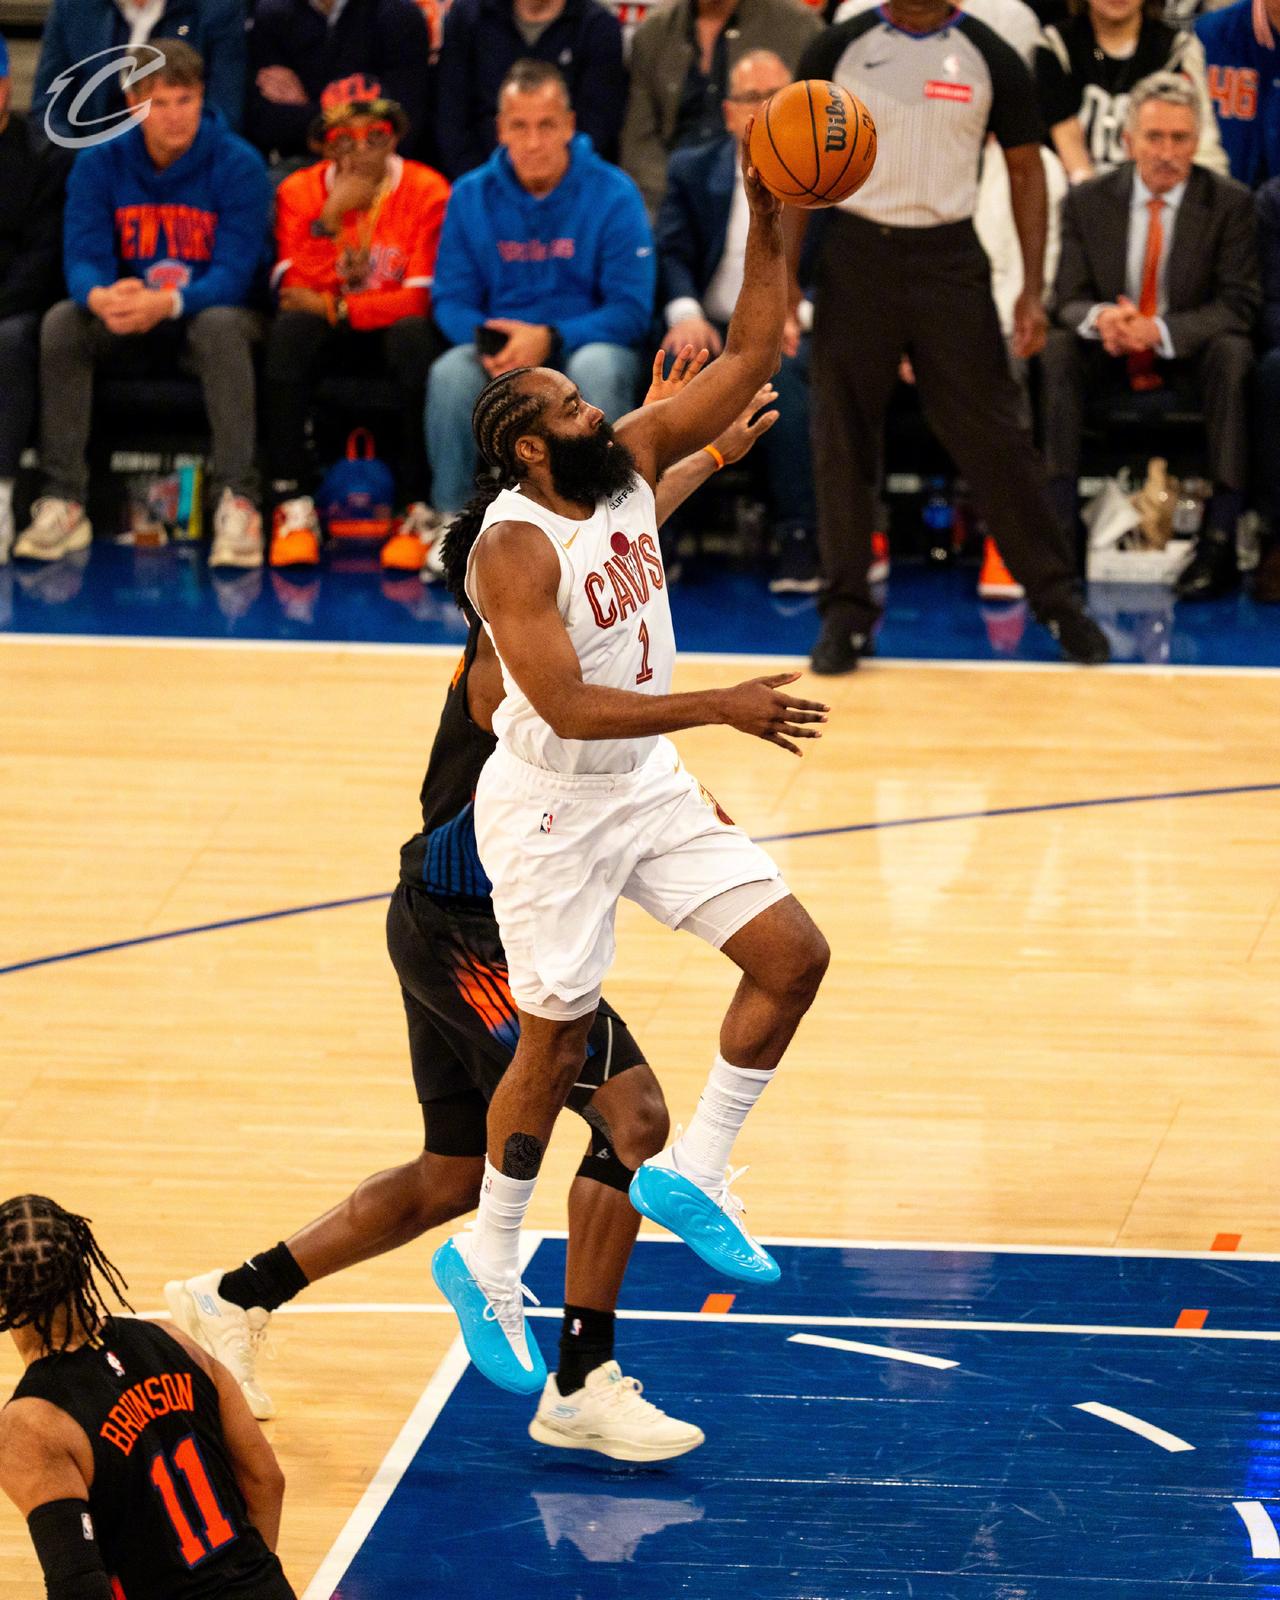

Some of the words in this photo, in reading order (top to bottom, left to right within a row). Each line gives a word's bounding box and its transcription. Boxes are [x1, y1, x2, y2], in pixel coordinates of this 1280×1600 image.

[1208, 64, 1260, 120] 46
[584, 532, 664, 630] CAVS
[635, 617, 654, 686] 1
[99, 1372, 195, 1457] BRUNSON
[151, 1433, 238, 1568] 11
